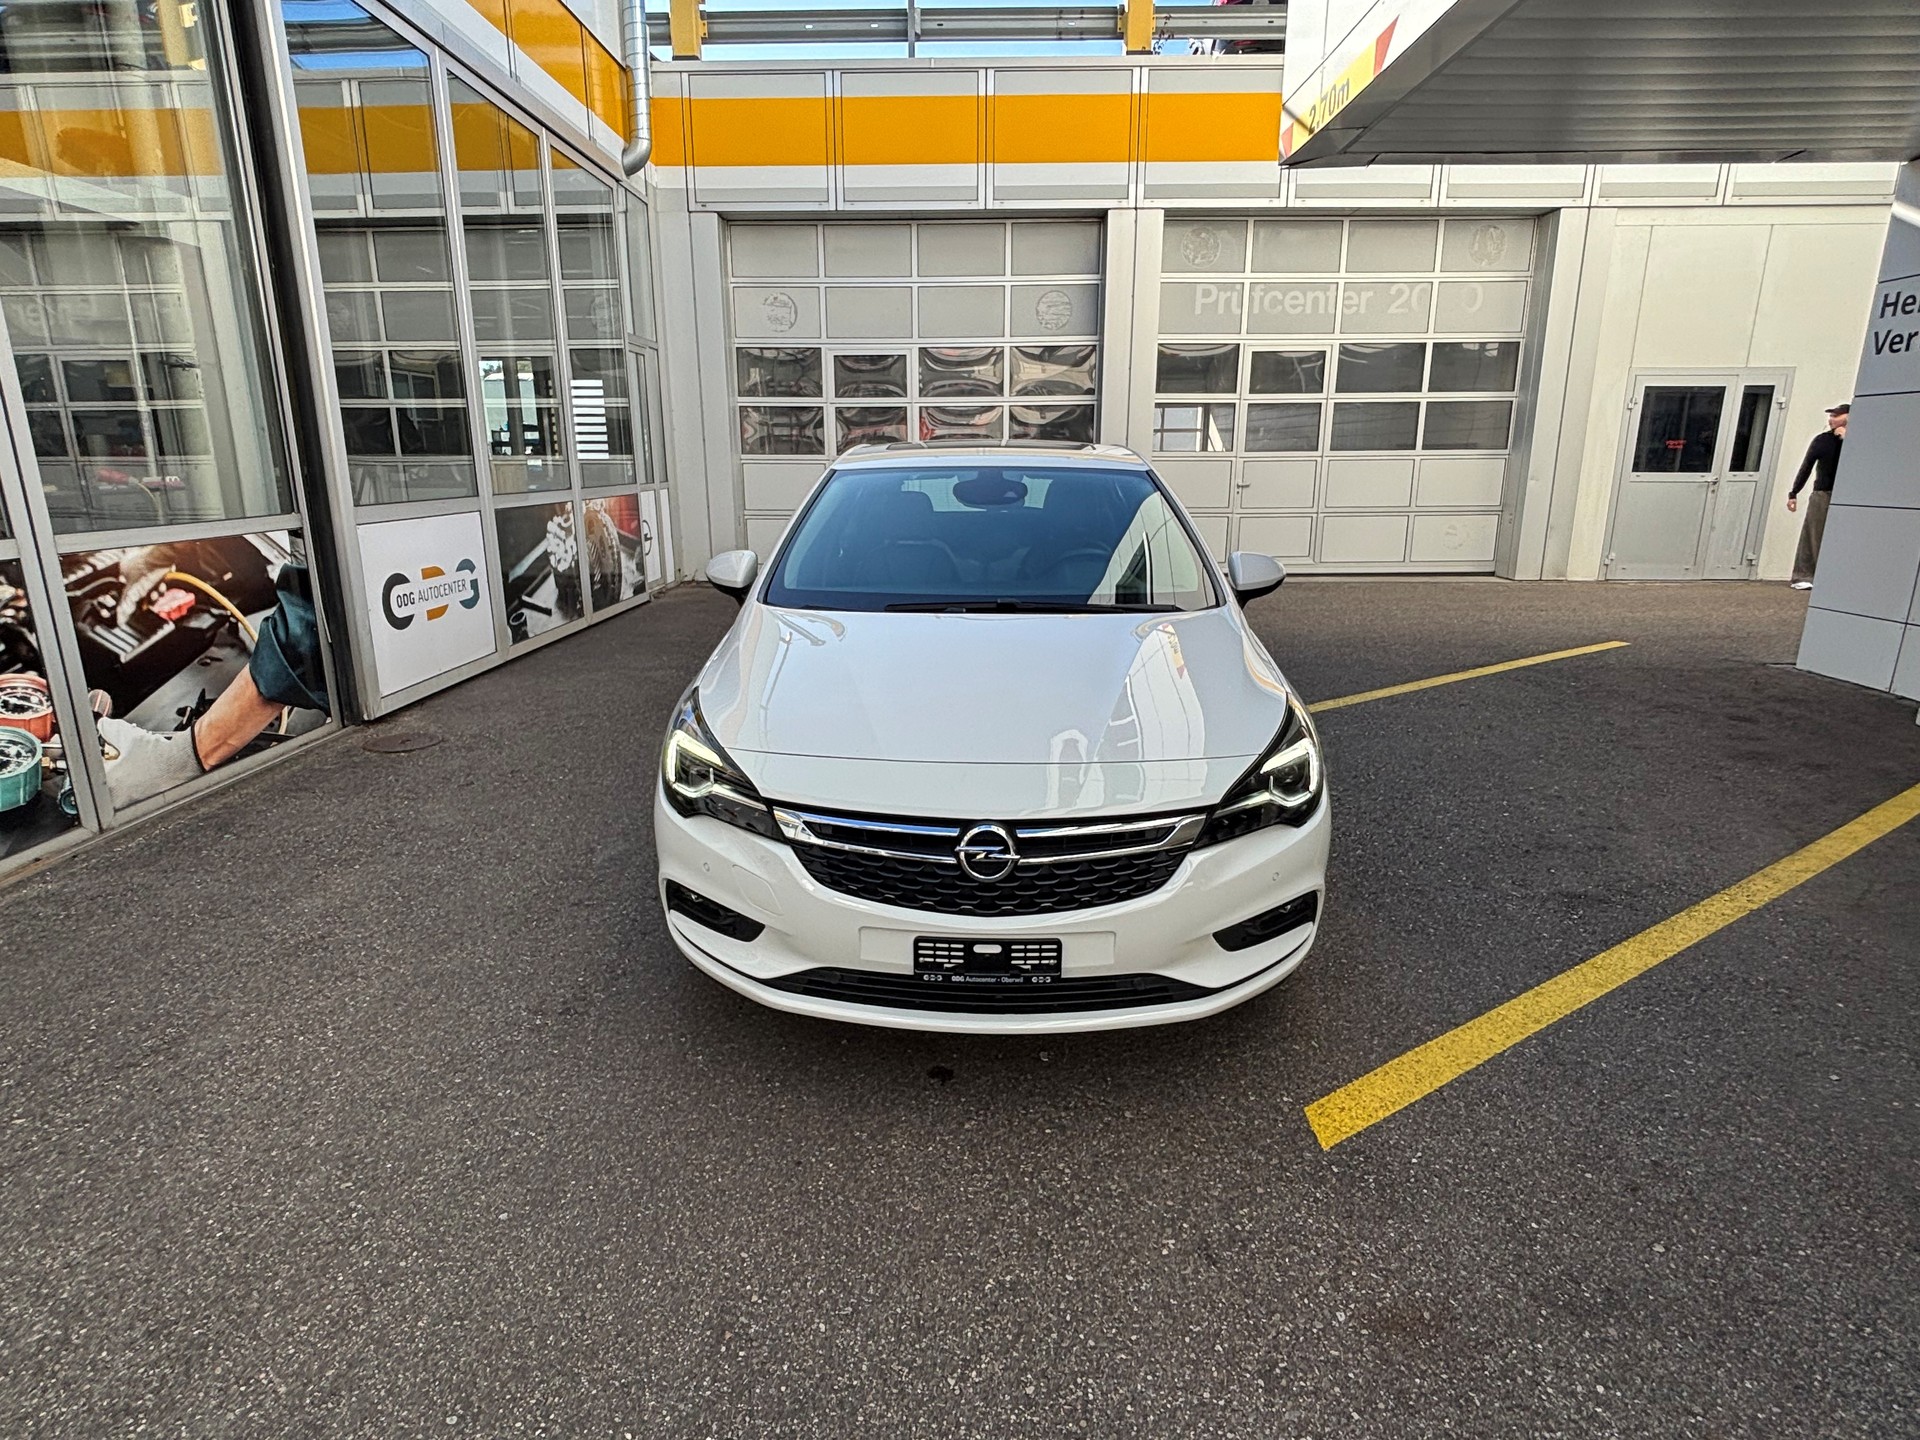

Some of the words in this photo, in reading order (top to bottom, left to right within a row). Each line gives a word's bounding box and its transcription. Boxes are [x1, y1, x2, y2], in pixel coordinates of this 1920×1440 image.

[1308, 77, 1350, 136] 2.70m
[1194, 283, 1374, 315] Prüfcenter
[1387, 282, 1484, 315] 200
[1879, 290, 1920, 319] He
[1873, 329, 1920, 355] Ver
[396, 592, 416, 609] ODG
[418, 578, 468, 603] AUTOCENTER
